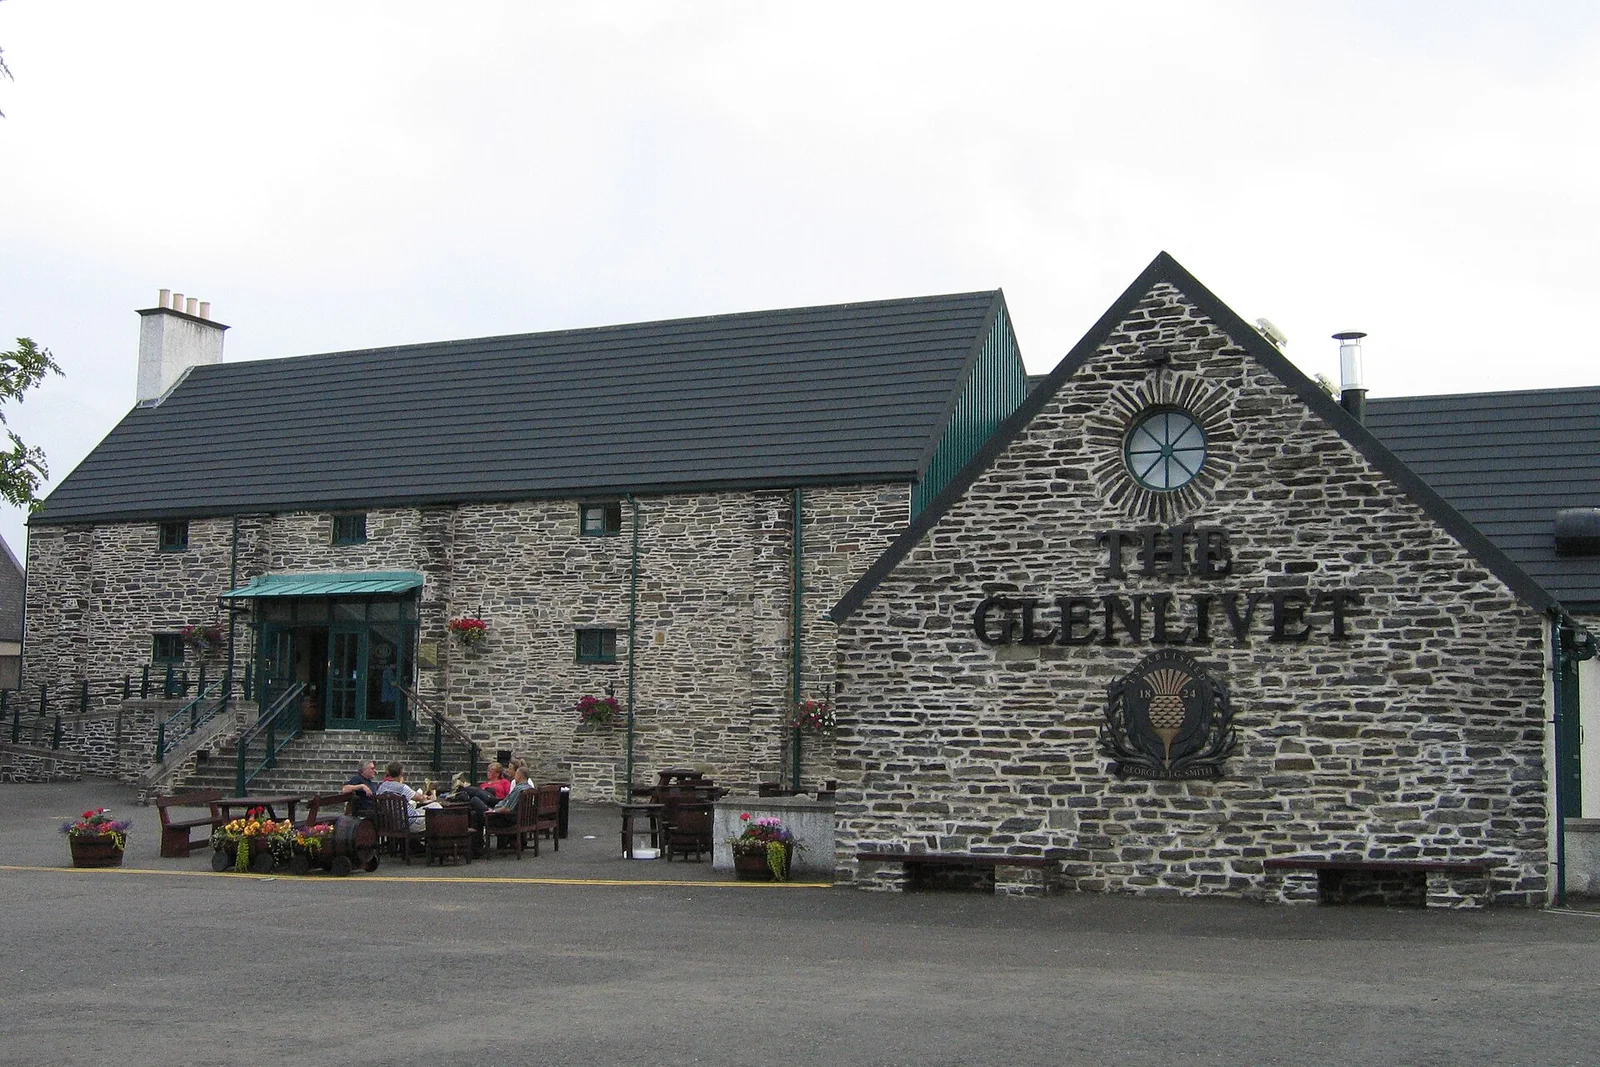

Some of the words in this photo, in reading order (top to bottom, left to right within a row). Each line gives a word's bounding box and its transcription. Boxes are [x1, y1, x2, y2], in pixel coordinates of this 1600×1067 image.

[1095, 526, 1231, 579] THE
[972, 591, 1365, 646] GLENLIVET
[1129, 652, 1206, 684] ESTABLISHED
[1140, 689, 1151, 699] 18
[1183, 689, 1197, 699] 24
[1122, 765, 1157, 777] GEORGE
[1160, 770, 1166, 778] &
[1185, 767, 1213, 777] SMITH
